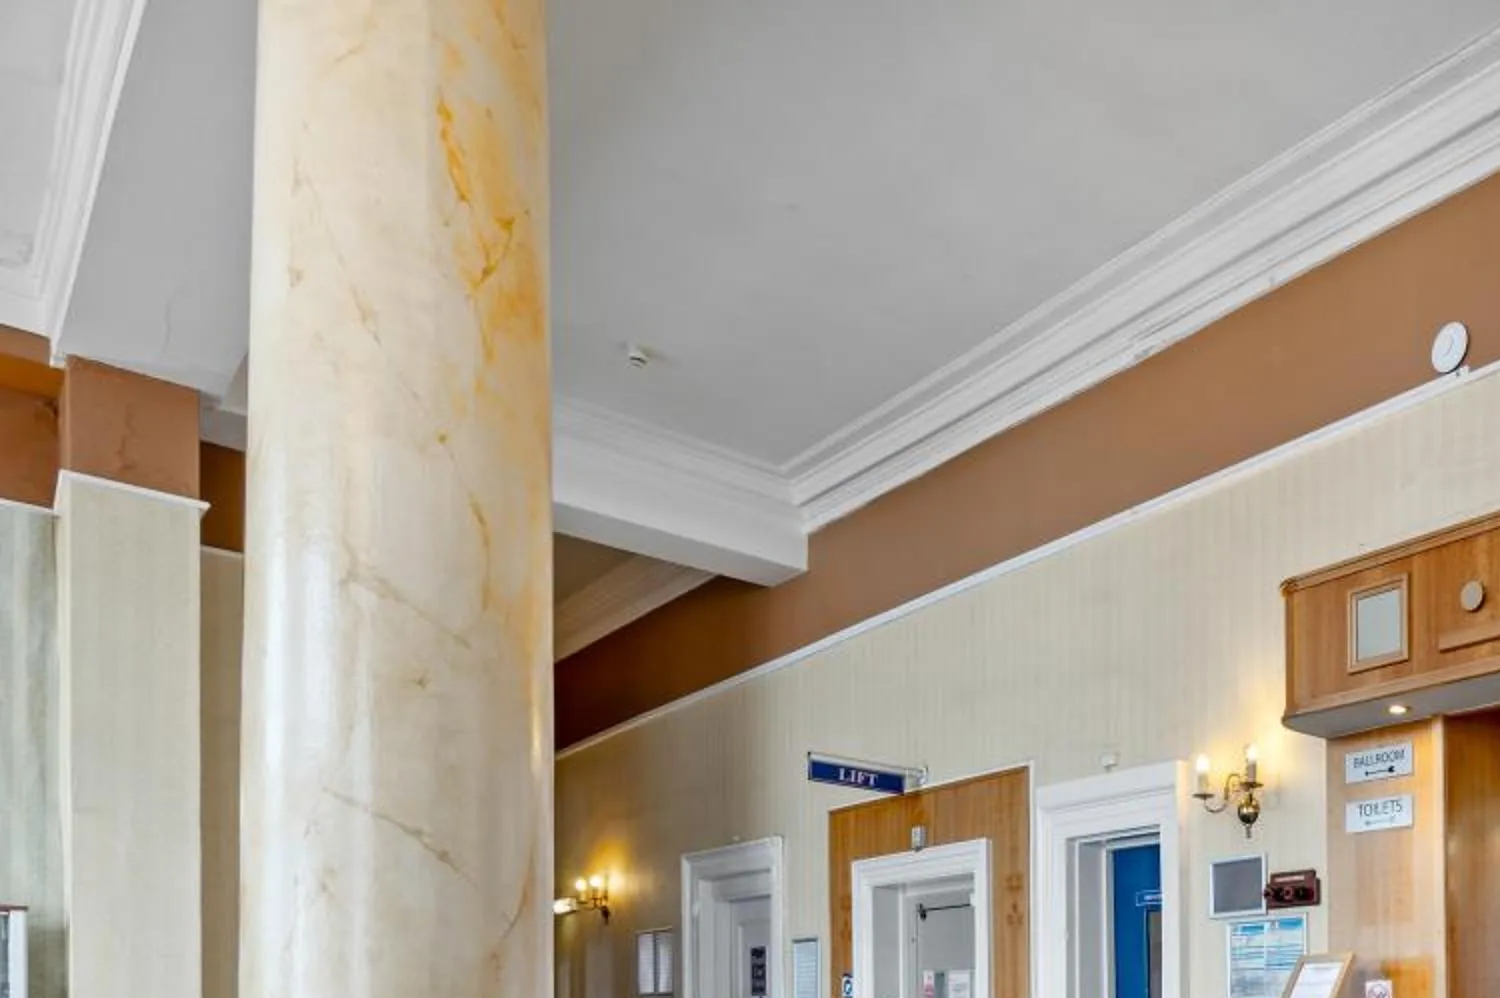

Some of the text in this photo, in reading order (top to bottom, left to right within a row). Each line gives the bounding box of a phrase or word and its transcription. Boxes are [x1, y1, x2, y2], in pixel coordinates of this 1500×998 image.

[1353, 749, 1405, 769] BALLROOM
[839, 768, 878, 786] LIFT
[1357, 798, 1403, 818] TOILETS
